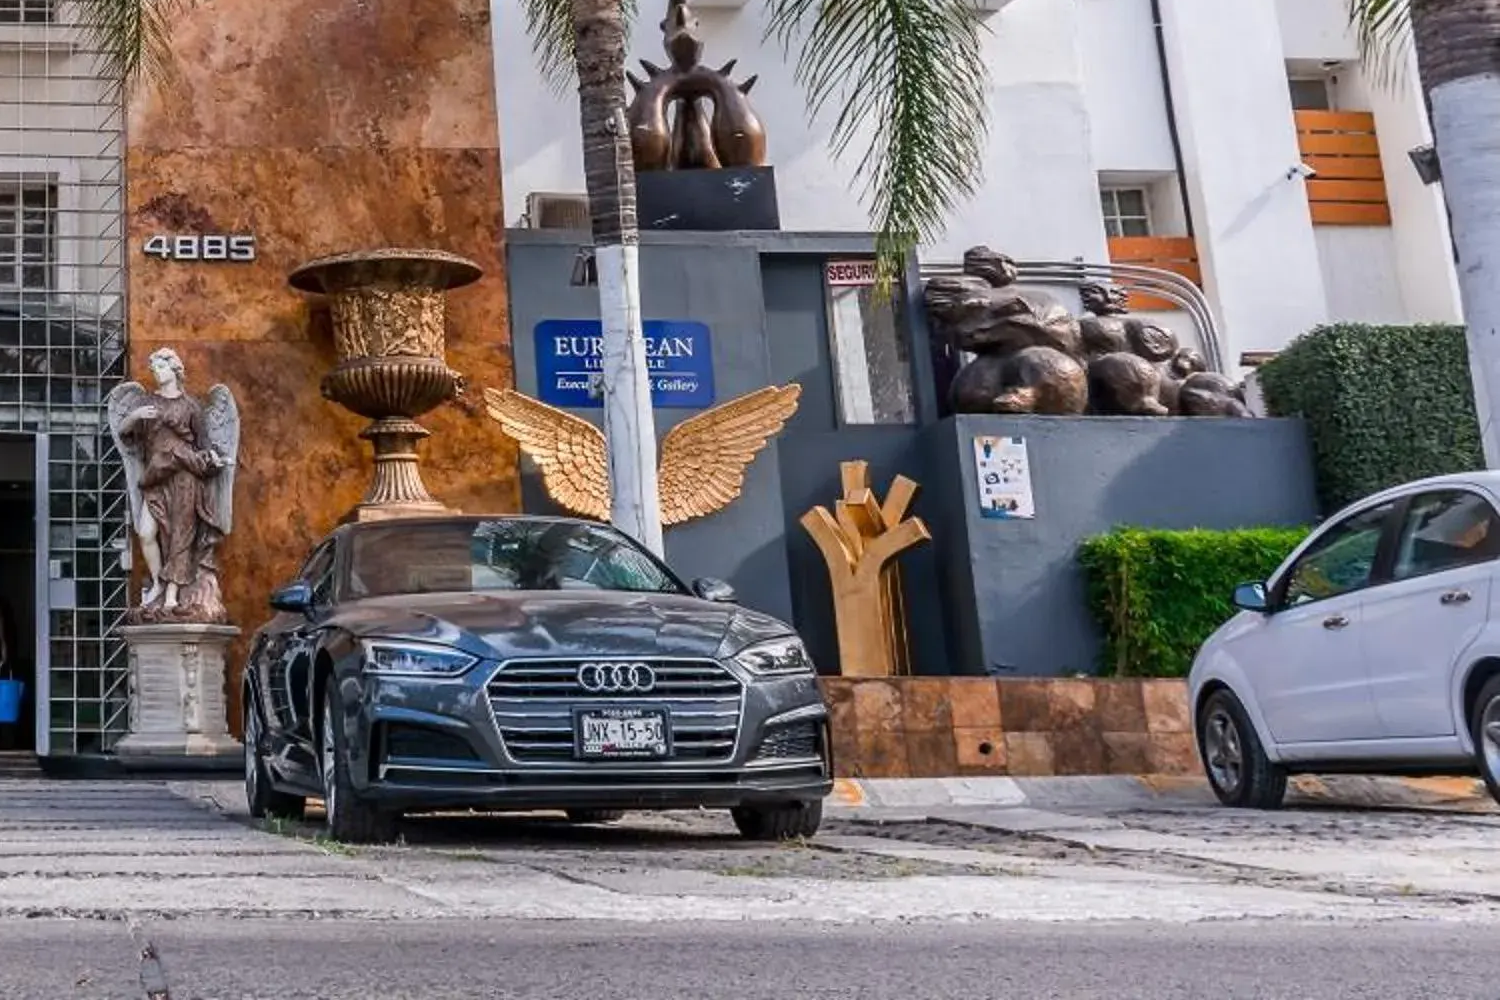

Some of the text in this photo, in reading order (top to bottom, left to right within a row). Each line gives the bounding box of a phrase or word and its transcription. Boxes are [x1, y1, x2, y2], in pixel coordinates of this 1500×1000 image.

[143, 234, 256, 260] 4885
[827, 263, 897, 281] SEGURI
[554, 336, 694, 357] EUREAN
[657, 376, 699, 393] Gallery
